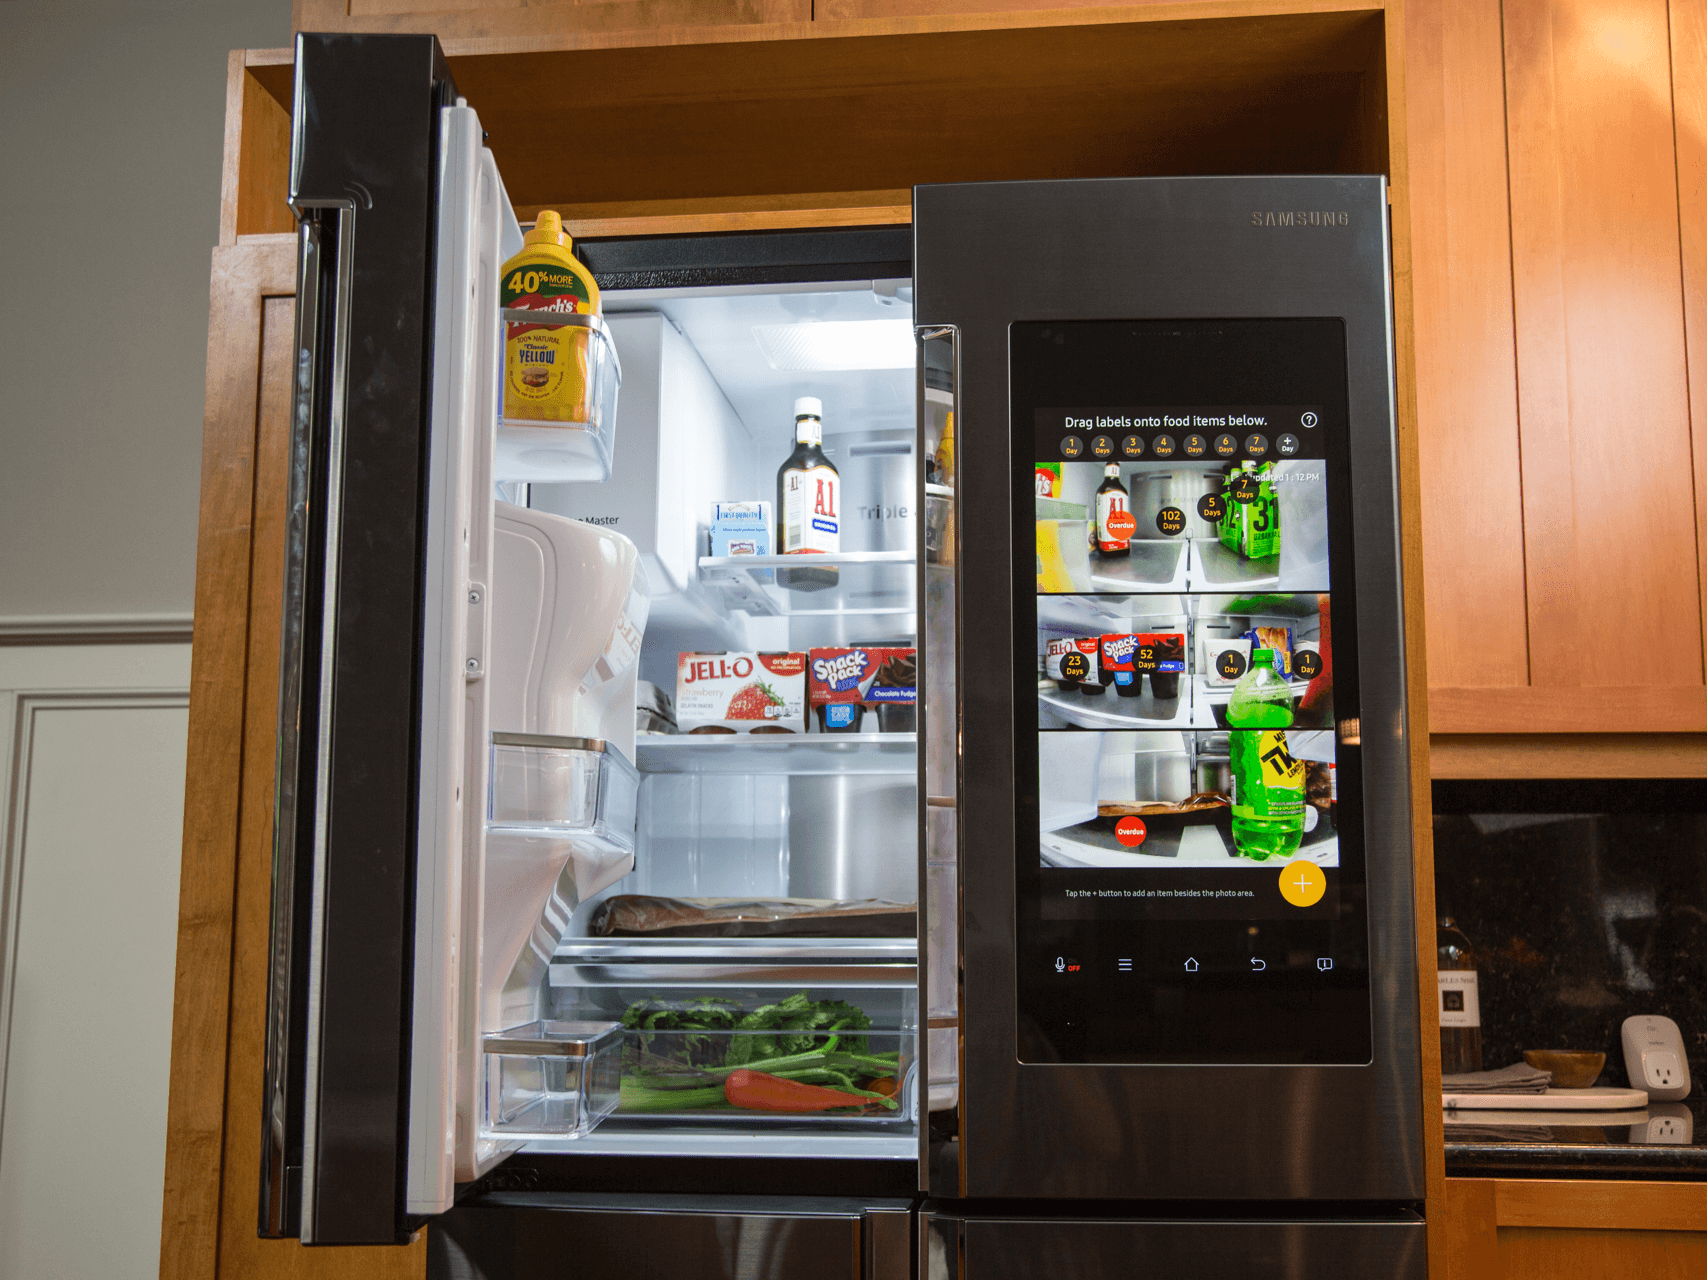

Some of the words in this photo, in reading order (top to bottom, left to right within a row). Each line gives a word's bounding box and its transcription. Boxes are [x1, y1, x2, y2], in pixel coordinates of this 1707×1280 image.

[1250, 211, 1349, 227] SAMSUNG
[508, 271, 549, 294] 40%
[549, 274, 574, 285] MORE
[533, 335, 560, 345] NATURAL
[519, 349, 556, 365] YELLOW
[1065, 416, 1093, 430] Drag
[1096, 415, 1132, 428] labels
[1133, 417, 1161, 427] onto
[1163, 415, 1190, 427] food
[1193, 415, 1226, 427] items
[1228, 414, 1268, 426] below.
[1069, 438, 1074, 446] 1
[1099, 438, 1105, 446] 2
[1130, 437, 1136, 446] 3
[1160, 437, 1167, 445] 4
[1191, 437, 1198, 445] 5
[1222, 436, 1229, 445] 6
[1253, 436, 1260, 445] 7
[1066, 447, 1078, 455] Day
[1281, 445, 1294, 453] Day
[1306, 473, 1320, 481] PM
[1241, 479, 1248, 489] 7
[1236, 491, 1254, 499] Days
[1208, 497, 1215, 507] 5
[857, 504, 908, 523] Triple
[1161, 511, 1181, 521] 102
[1203, 509, 1221, 517] Days
[585, 516, 620, 526] Master
[1162, 522, 1181, 531] Days
[1103, 636, 1139, 657] Snack
[1140, 649, 1153, 659] 52
[772, 658, 800, 667] original
[1068, 656, 1081, 666] 23
[1228, 654, 1234, 664] 1
[1304, 654, 1310, 664] 1
[813, 650, 868, 680] Snack
[1138, 661, 1156, 669] Days
[684, 656, 754, 684] JELL-O
[1066, 668, 1084, 676] Days
[1224, 666, 1238, 675] Day
[1300, 666, 1314, 675] Day
[680, 688, 724, 698] strawberry
[1065, 889, 1078, 898] Tap
[1079, 889, 1091, 897] the
[1098, 889, 1122, 897] button
[1132, 889, 1145, 897] add
[1156, 889, 1173, 897] item
[1174, 889, 1201, 897] besides
[1202, 889, 1214, 897] the
[1215, 889, 1236, 898] photo
